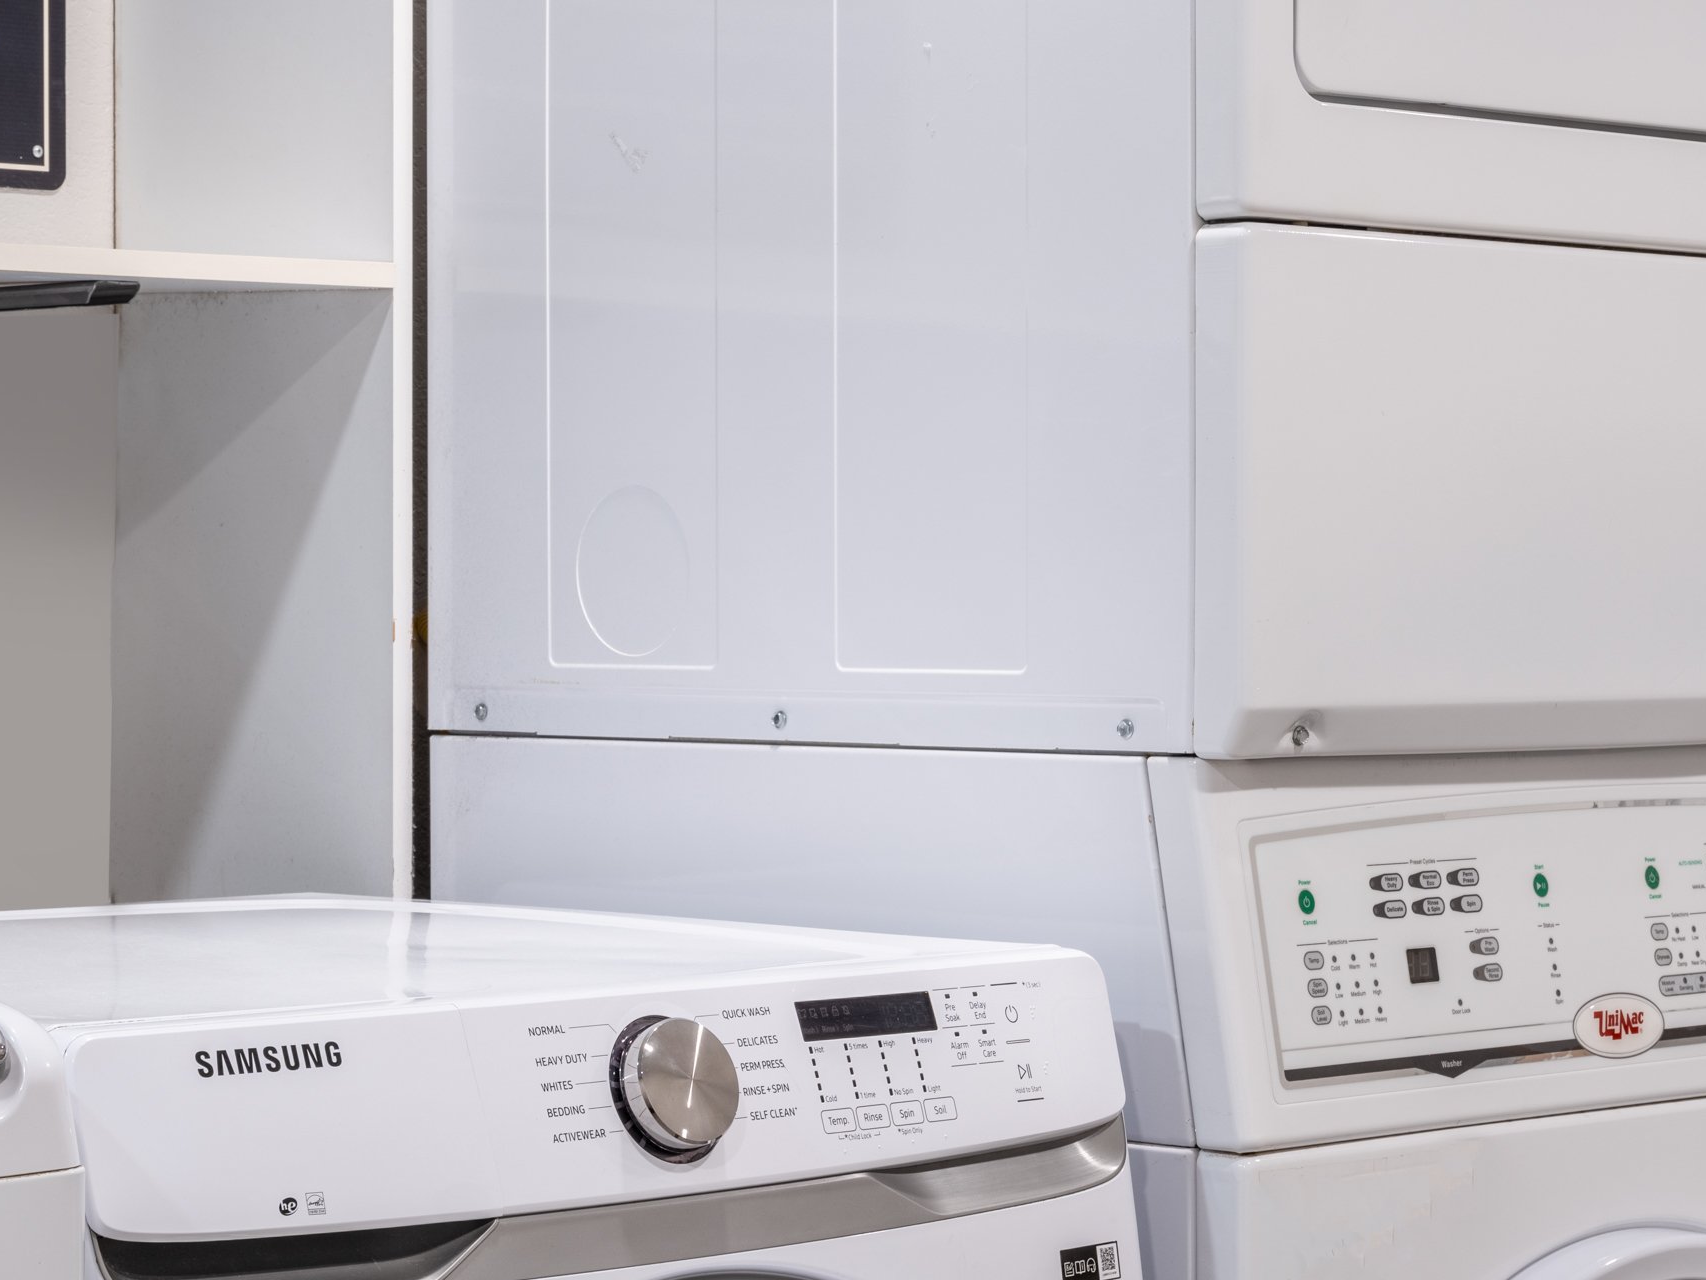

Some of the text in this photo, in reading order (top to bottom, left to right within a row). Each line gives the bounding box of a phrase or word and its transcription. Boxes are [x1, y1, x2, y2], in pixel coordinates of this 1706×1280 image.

[969, 1001, 986, 1010] Delay
[722, 1007, 771, 1019] QUICK WASH
[974, 1012, 986, 1020] End
[1594, 1009, 1644, 1040] UniMac
[528, 1025, 565, 1036] NORMAL
[737, 1035, 778, 1047] DELICATES
[978, 1039, 996, 1047] Smart
[195, 1041, 342, 1078] SAMSUNG
[535, 1054, 587, 1067] HEAVY DUTY
[957, 1052, 967, 1060] Off
[741, 1059, 785, 1072] PERM PRESS
[1441, 1059, 1463, 1068] Washer
[541, 1080, 573, 1092] WHITES
[743, 1086, 766, 1096] RINSE
[772, 1084, 790, 1094] SPIN
[547, 1105, 585, 1117] BEDDING
[750, 1111, 768, 1120] SELF
[899, 1109, 915, 1119] Spin
[934, 1106, 947, 1115] Soil
[828, 1117, 850, 1126] Temp.
[864, 1113, 883, 1121] Rinse
[553, 1129, 606, 1143] ACTIVEWEAR
